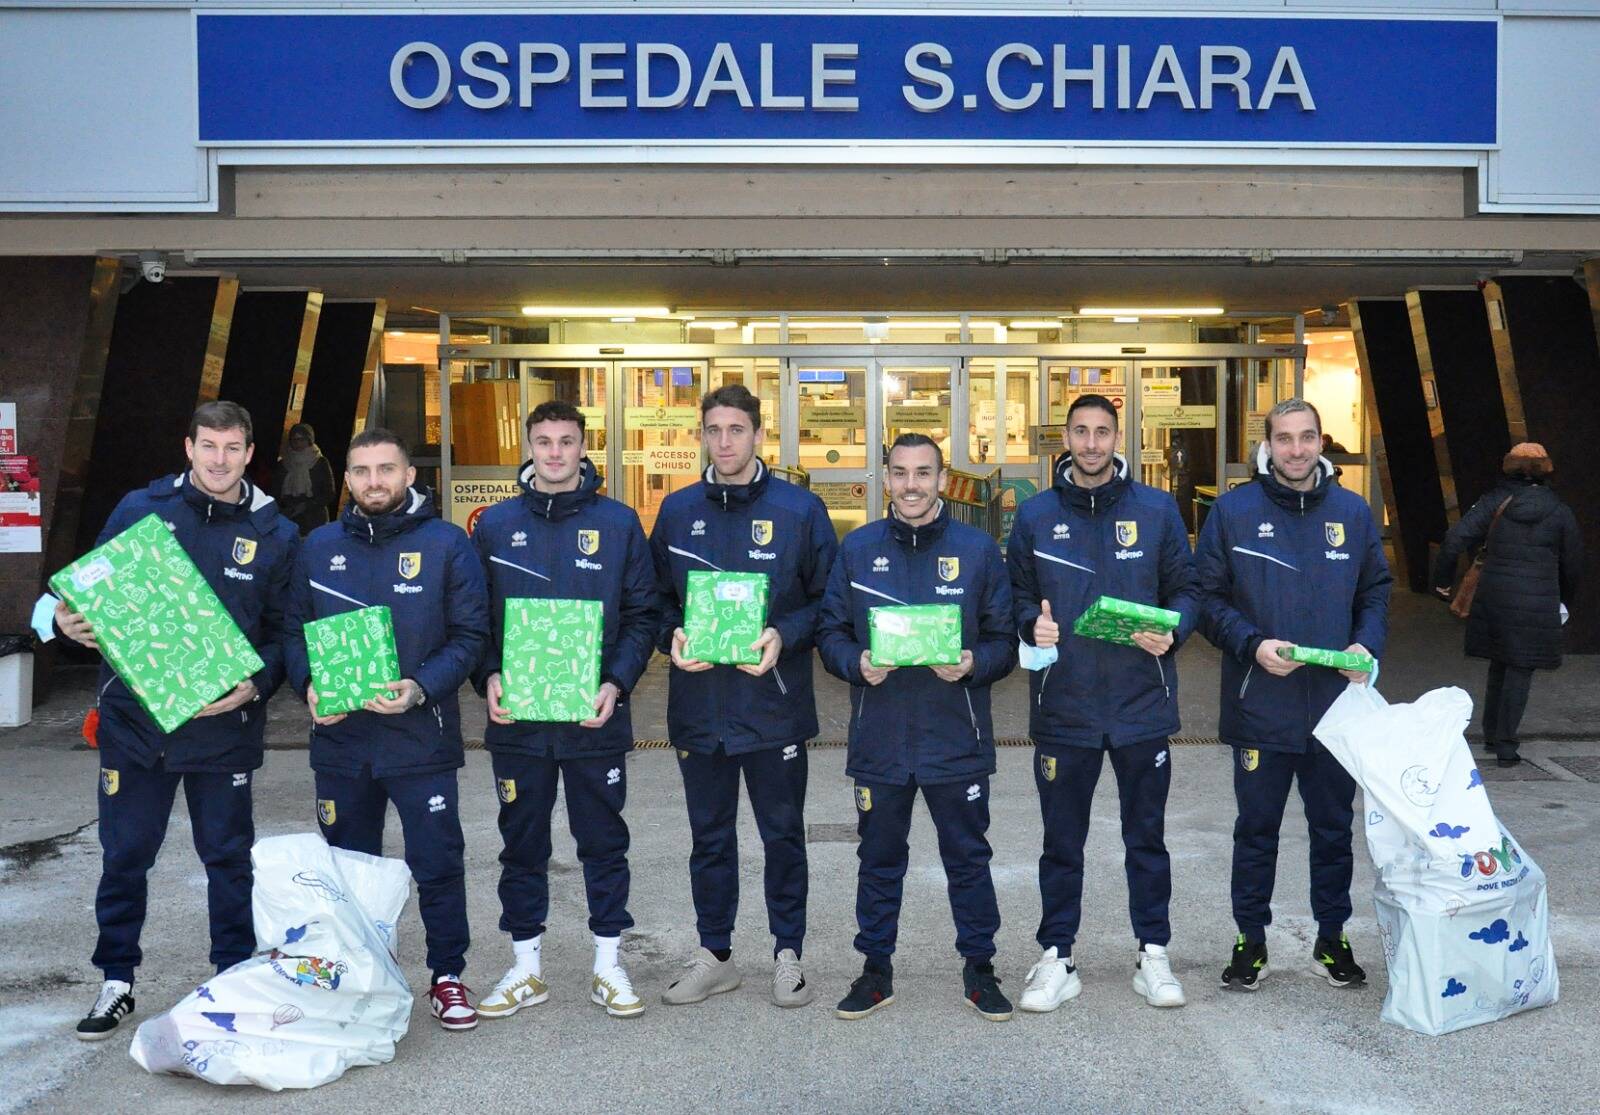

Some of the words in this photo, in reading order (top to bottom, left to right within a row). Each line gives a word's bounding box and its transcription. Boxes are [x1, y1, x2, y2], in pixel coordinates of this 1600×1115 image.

[390, 41, 859, 110] OSPEDALE
[902, 42, 1317, 112] S.CHIARA
[650, 451, 696, 460] ACCESSO
[654, 461, 691, 470] CHIUSO
[454, 484, 518, 494] OSPEDALE
[454, 495, 487, 503] SENZA
[489, 495, 518, 503] FUM
[1477, 882, 1499, 891] DOVE
